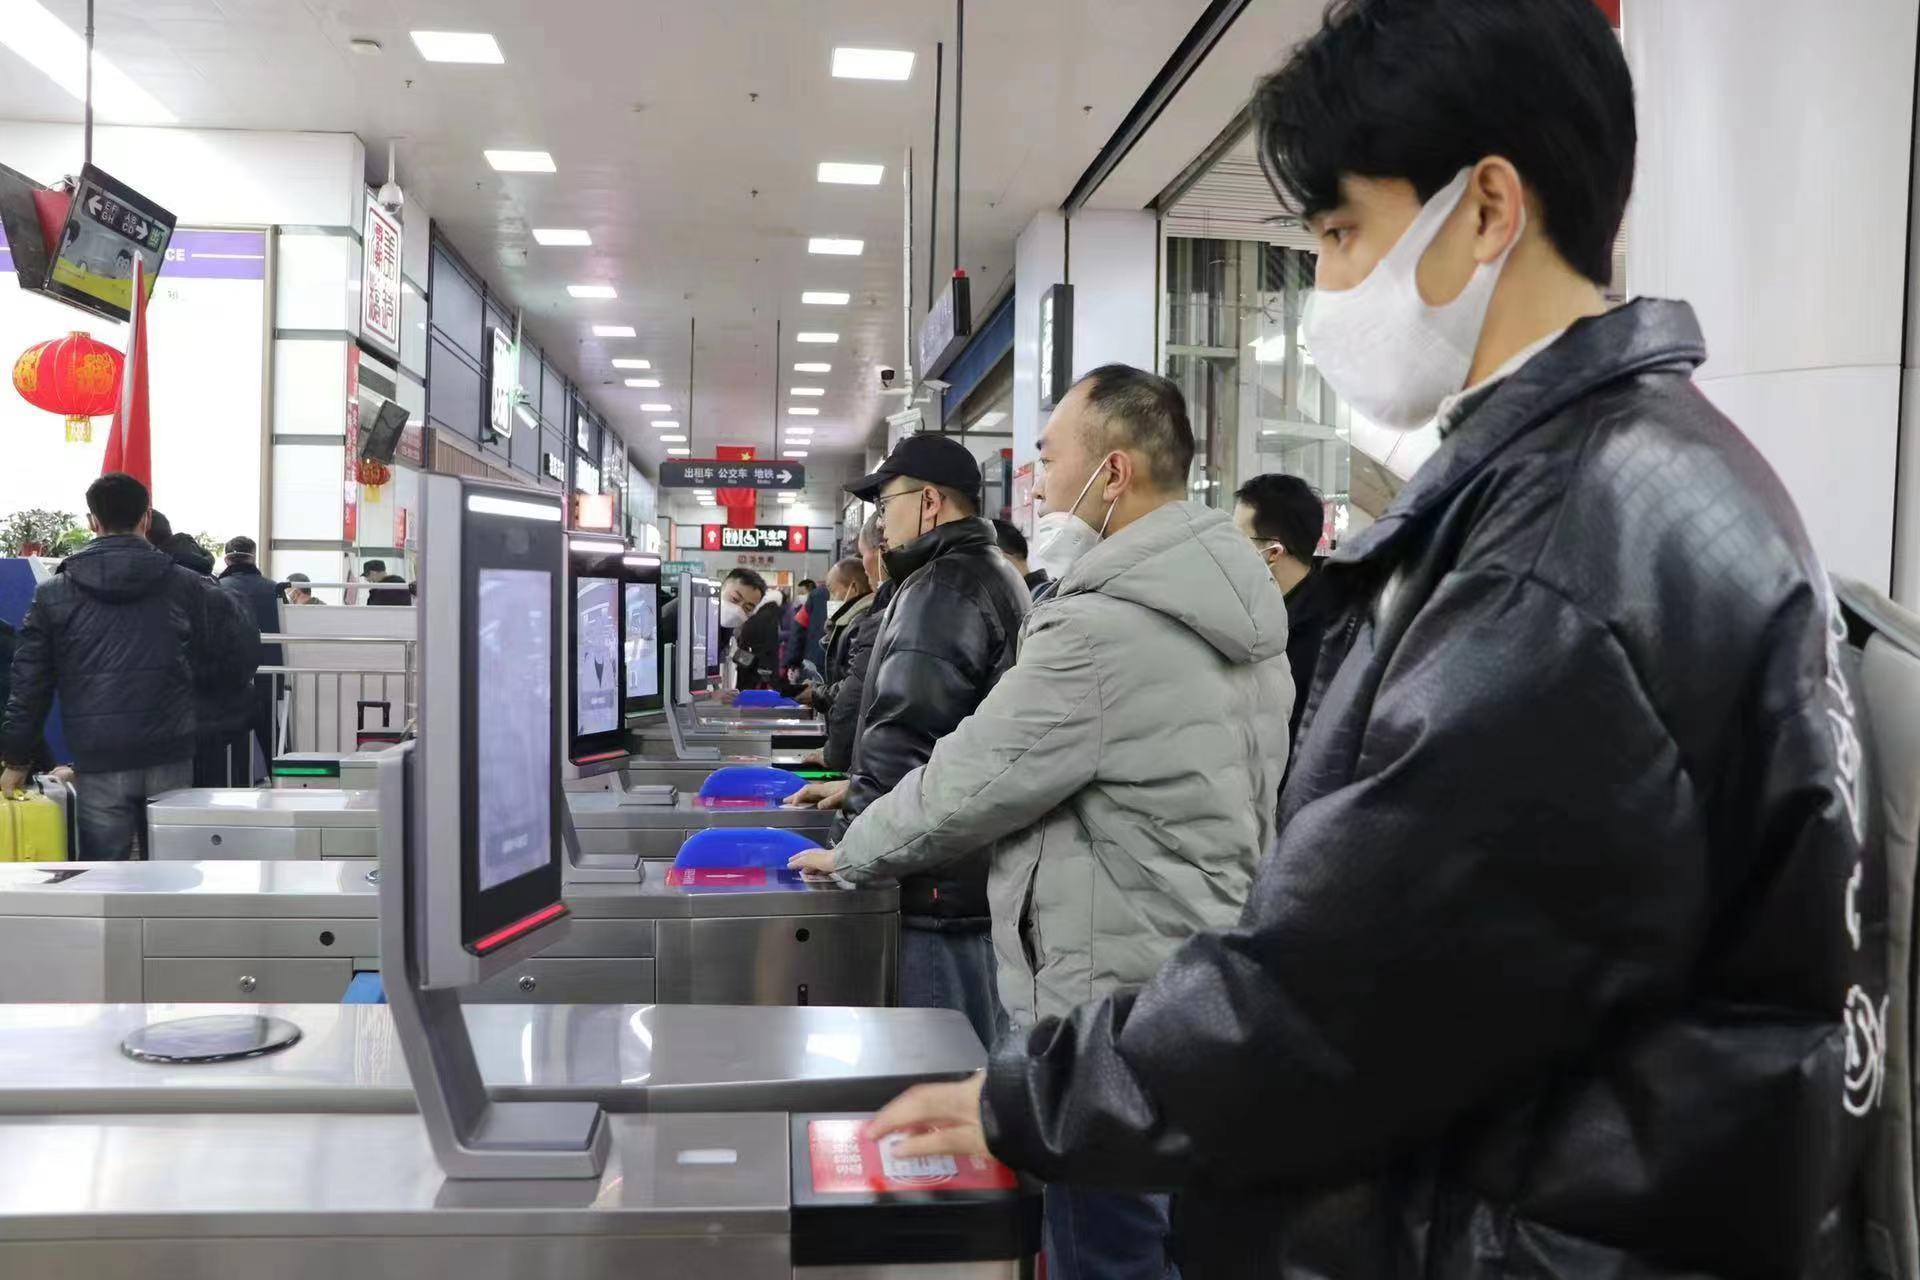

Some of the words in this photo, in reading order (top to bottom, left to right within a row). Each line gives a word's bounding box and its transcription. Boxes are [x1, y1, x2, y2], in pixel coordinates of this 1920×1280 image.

[684, 468, 714, 478] 出租车
[718, 468, 748, 478] 公交车
[754, 468, 774, 479] 地铁
